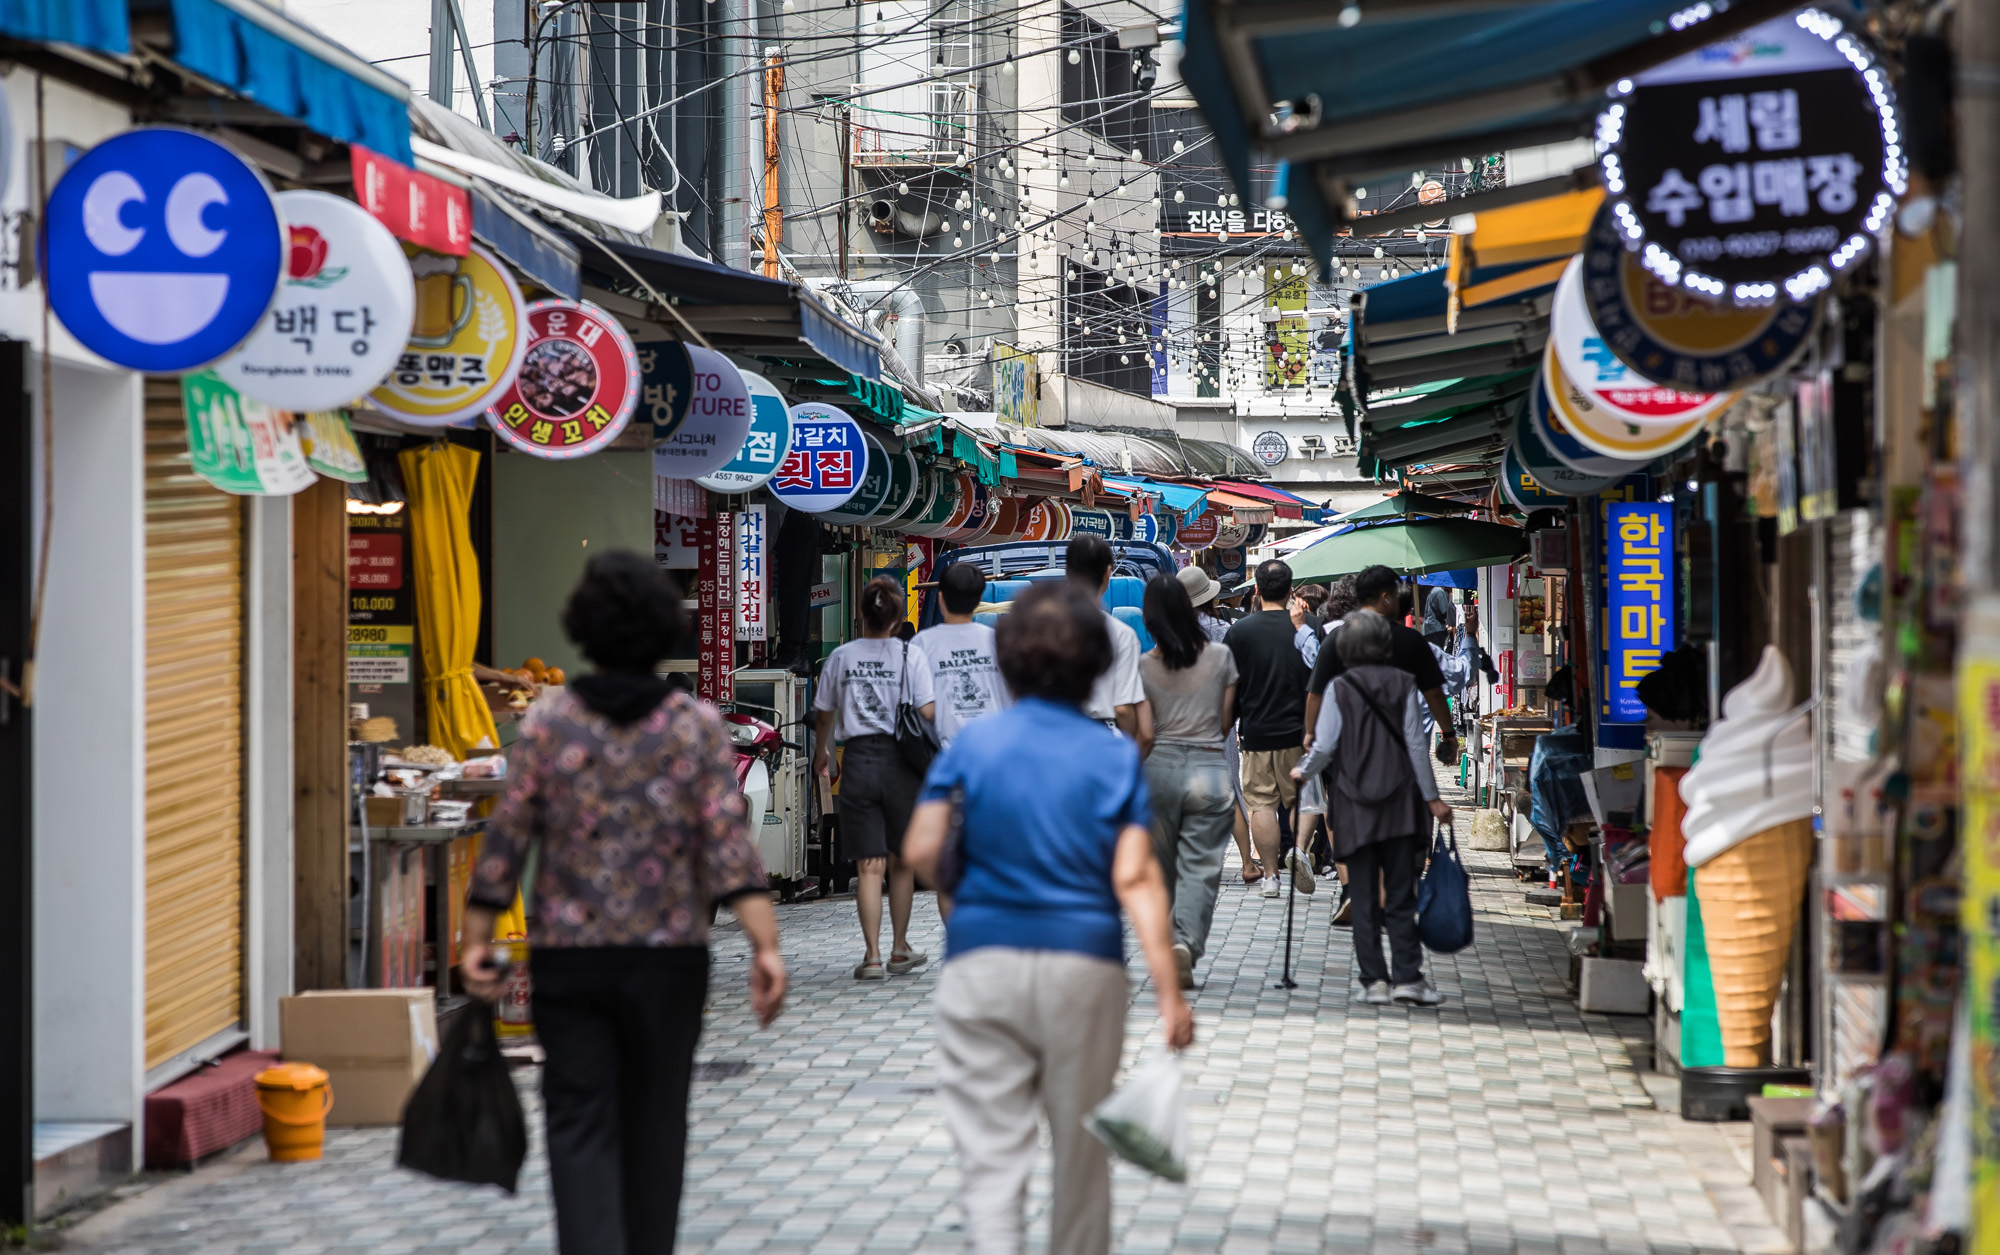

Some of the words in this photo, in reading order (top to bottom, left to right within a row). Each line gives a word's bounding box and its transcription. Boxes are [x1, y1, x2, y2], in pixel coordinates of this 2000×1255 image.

[1646, 153, 1863, 226] 수입매장
[1187, 210, 1246, 232] 진심을
[272, 305, 376, 357] 백당
[644, 383, 678, 427] 방
[502, 403, 613, 445] 인생꼬치
[666, 433, 716, 447] 시그니처
[736, 431, 777, 463] 점
[714, 473, 733, 481] 4557
[735, 474, 754, 483] 9942
[775, 450, 853, 490] 횟집
[861, 475, 881, 499] 전
[719, 512, 731, 601] 포장해드립니다
[740, 512, 763, 577] 자갈치
[811, 588, 831, 600] PEN
[701, 615, 713, 645] 전통
[857, 661, 885, 670] NEW
[938, 657, 992, 670] BALANCE
[951, 649, 978, 658] NEW
[701, 652, 714, 704] 하동식
[844, 669, 896, 679] BALANCE
